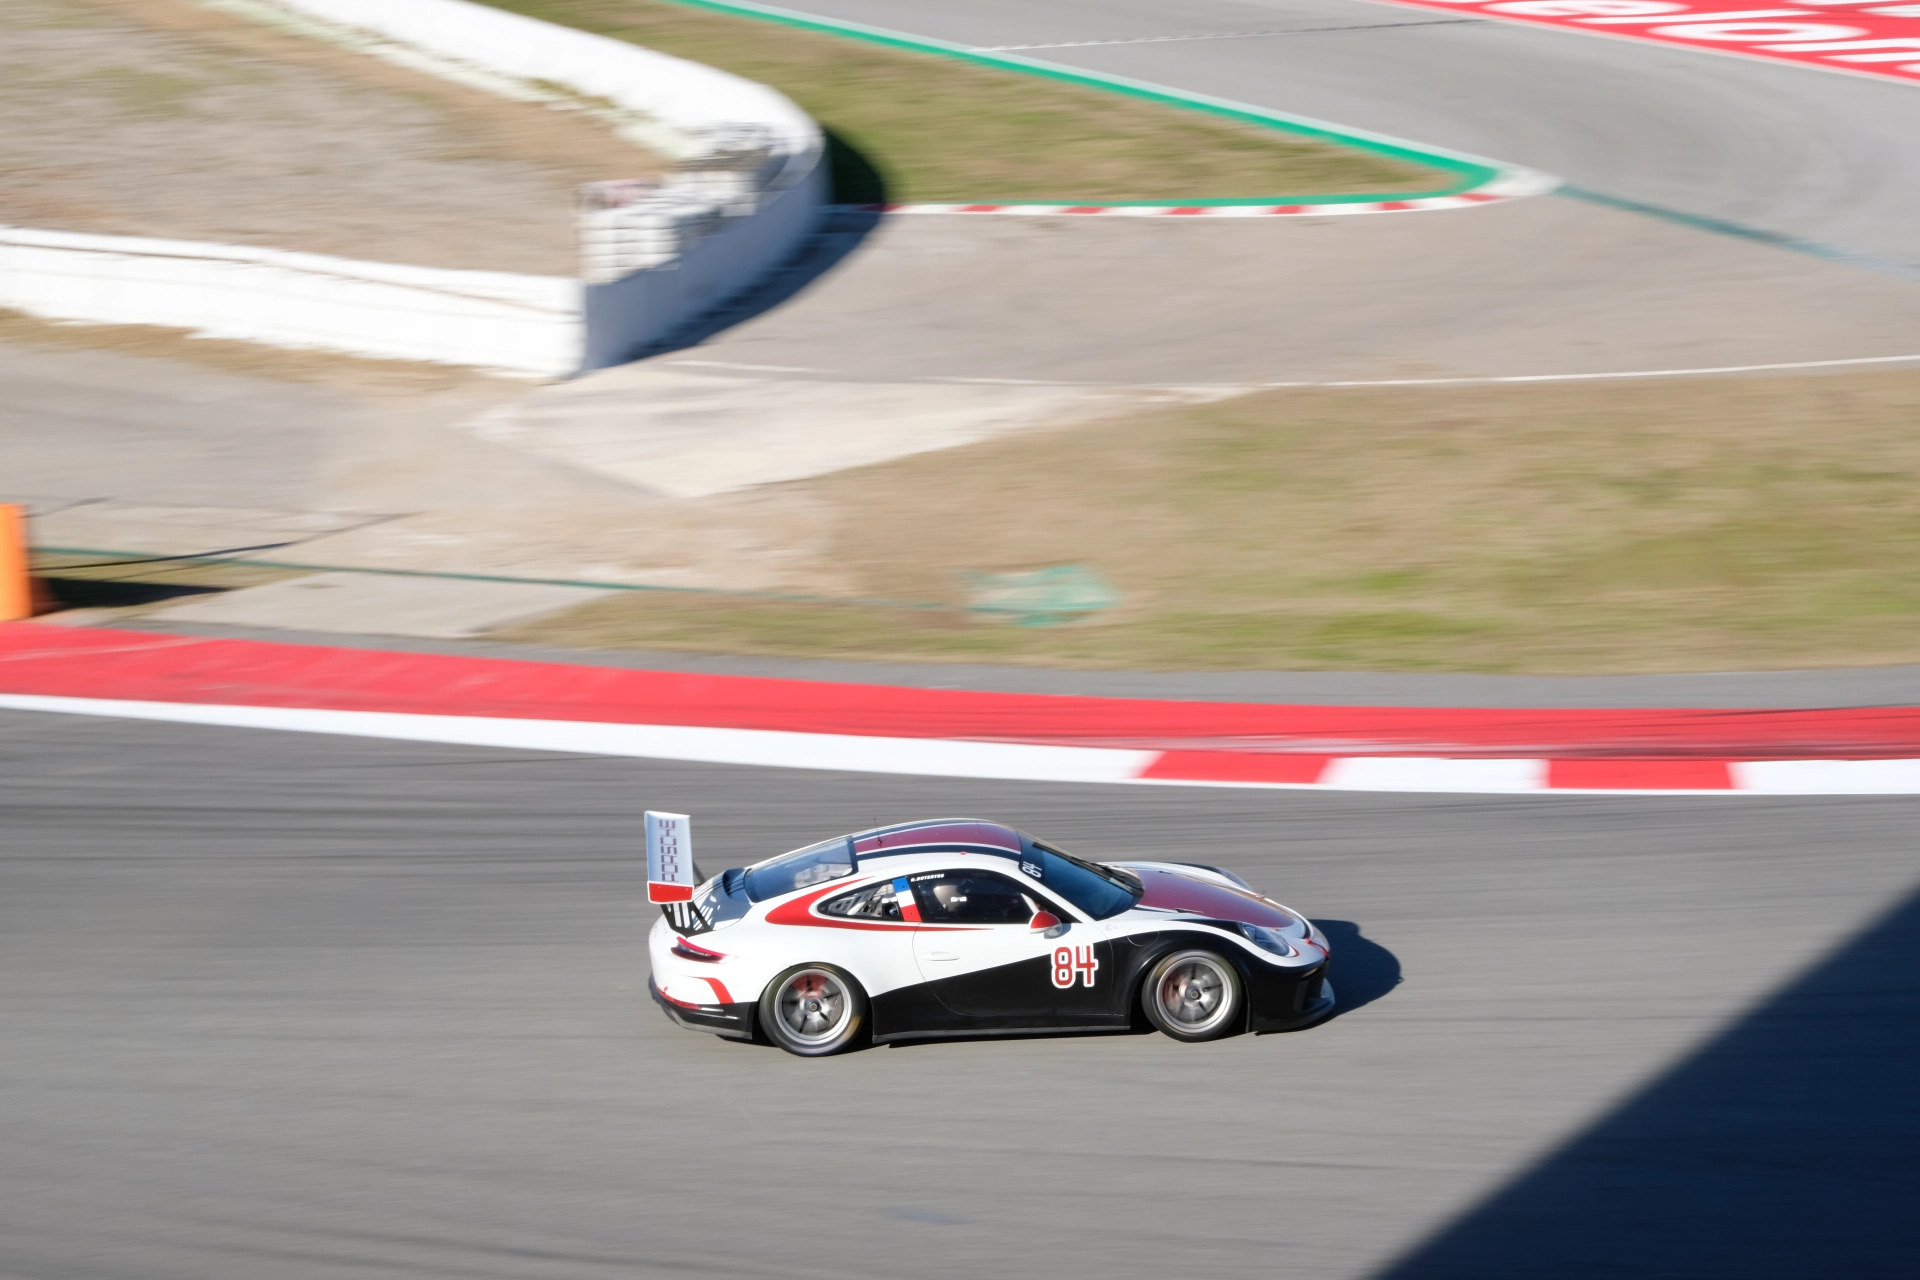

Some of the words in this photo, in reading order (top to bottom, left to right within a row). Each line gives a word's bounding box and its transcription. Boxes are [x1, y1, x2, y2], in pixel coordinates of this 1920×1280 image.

[658, 819, 679, 883] PORSCHE
[1021, 860, 1043, 878] 84
[1052, 944, 1098, 988] 84
